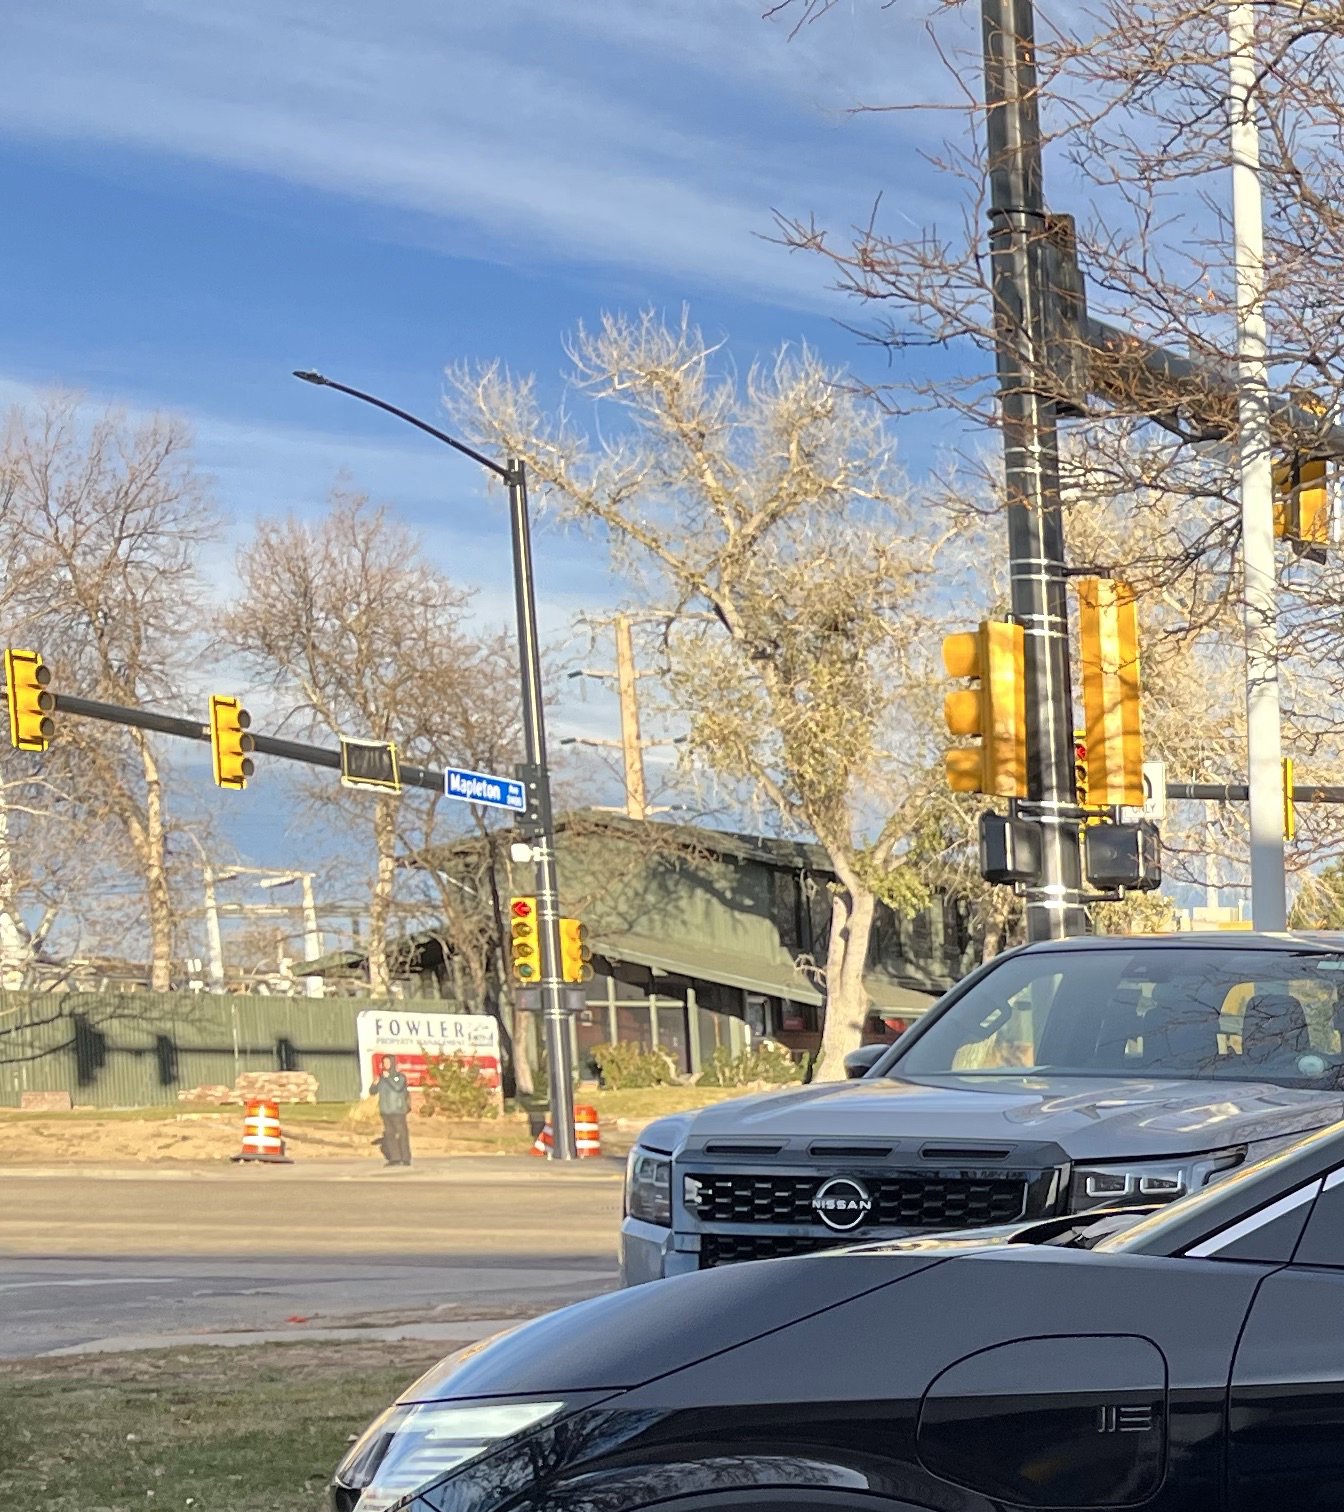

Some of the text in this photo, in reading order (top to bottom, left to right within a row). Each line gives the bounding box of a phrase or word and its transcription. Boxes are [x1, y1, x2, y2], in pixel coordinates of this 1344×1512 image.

[450, 773, 501, 801] Mapleton
[375, 1019, 464, 1038] FOWLER
[812, 1200, 871, 1210] NISSAN
